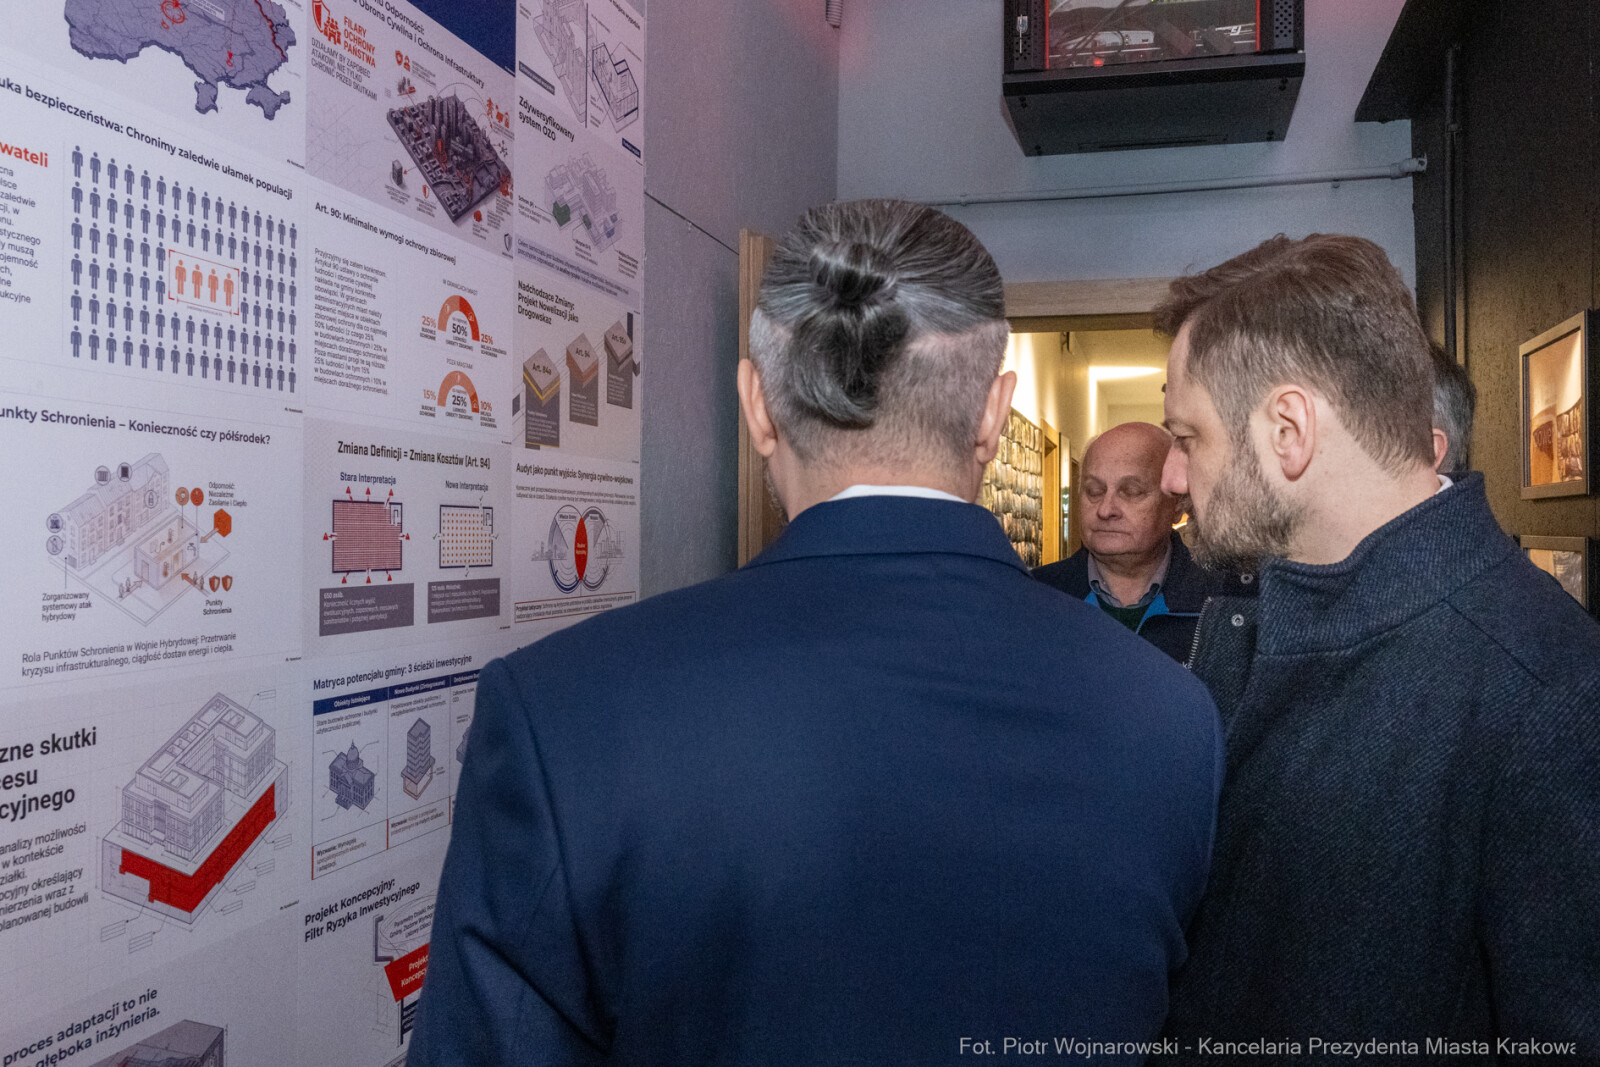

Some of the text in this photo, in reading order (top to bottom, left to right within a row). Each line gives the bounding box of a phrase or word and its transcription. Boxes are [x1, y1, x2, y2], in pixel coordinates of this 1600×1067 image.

[344, 16, 367, 38] FILARY
[344, 29, 376, 55] OCHRONY
[386, 16, 413, 40] Cywilna
[417, 37, 444, 61] Ochrona
[445, 55, 485, 89] Infrastruktury
[344, 40, 376, 68] PAŃSTWA
[518, 111, 541, 132] system
[519, 95, 575, 142] Zdywersyfikowany
[25, 85, 123, 133] bezpieczeństwa:
[126, 126, 176, 155] Chronimy
[178, 147, 220, 171] zaledwie
[222, 164, 254, 184] ułamek
[256, 178, 293, 200] populacji
[0, 142, 48, 167] wateli
[0, 191, 36, 208] zaledwie
[12, 207, 20, 215] w
[315, 202, 456, 265] Art. 90: Minimalne wymogi ochrony zbiorowej
[7, 242, 35, 257] muszą
[518, 279, 554, 303] Nadchodzące
[517, 304, 552, 325] Drogowskaz
[518, 292, 579, 323] Projekt Nowelizacji jako
[421, 315, 437, 329] 25%
[452, 323, 468, 337] 50%
[481, 333, 494, 345] 25%
[423, 389, 437, 401] 15%
[452, 394, 467, 407] 25%
[480, 400, 493, 412] 10%
[41, 410, 116, 429] Schronienia
[129, 419, 198, 437] Konieczność
[200, 430, 217, 441] czy
[219, 430, 270, 445] półśrodek?
[337, 440, 369, 456] Zmiana
[370, 444, 402, 462] Definicji
[409, 449, 435, 464] Zmiana
[436, 452, 464, 466] Kosztów
[340, 471, 397, 486] Stara Interpretacja
[516, 463, 532, 476] Audyt
[445, 480, 459, 489] Nowa
[42, 592, 90, 602] Zorganizowany
[42, 601, 92, 612] systemowy atak
[41, 613, 76, 623] hybrydowy
[203, 607, 232, 615] Schronienia
[22, 652, 42, 663] Rola
[43, 648, 79, 661] Punktów
[80, 642, 125, 657] Schronienia
[134, 640, 158, 652] Wojnie
[200, 632, 236, 644] Przetrwanie
[21, 665, 54, 678] kryzysu
[55, 656, 131, 673] infrastrukturalnego,
[131, 652, 161, 664] ciągłość
[162, 650, 187, 659] dostaw
[188, 646, 209, 656] energii
[313, 676, 345, 691] Matryca
[346, 668, 384, 687] potencjału
[385, 665, 407, 680] gminy:
[408, 664, 413, 674] 3
[413, 659, 435, 673] ścieżki
[0, 726, 96, 763] zne skutki
[0, 769, 37, 790] esu
[0, 788, 75, 822] cyjnego
[0, 822, 86, 855] analizy możliwości
[2, 844, 64, 869] w kontekście
[31, 868, 83, 890] określający
[45, 887, 67, 900] wraz
[69, 885, 74, 893] z
[53, 892, 88, 913] budowli
[304, 878, 396, 926] Projekt Koncepcyjny:
[304, 881, 421, 943] Filtr Ryzyka Inwestycyjnego
[3, 988, 157, 1067] proces adaptacji to nie
[96, 1007, 160, 1043] inżynieria.
